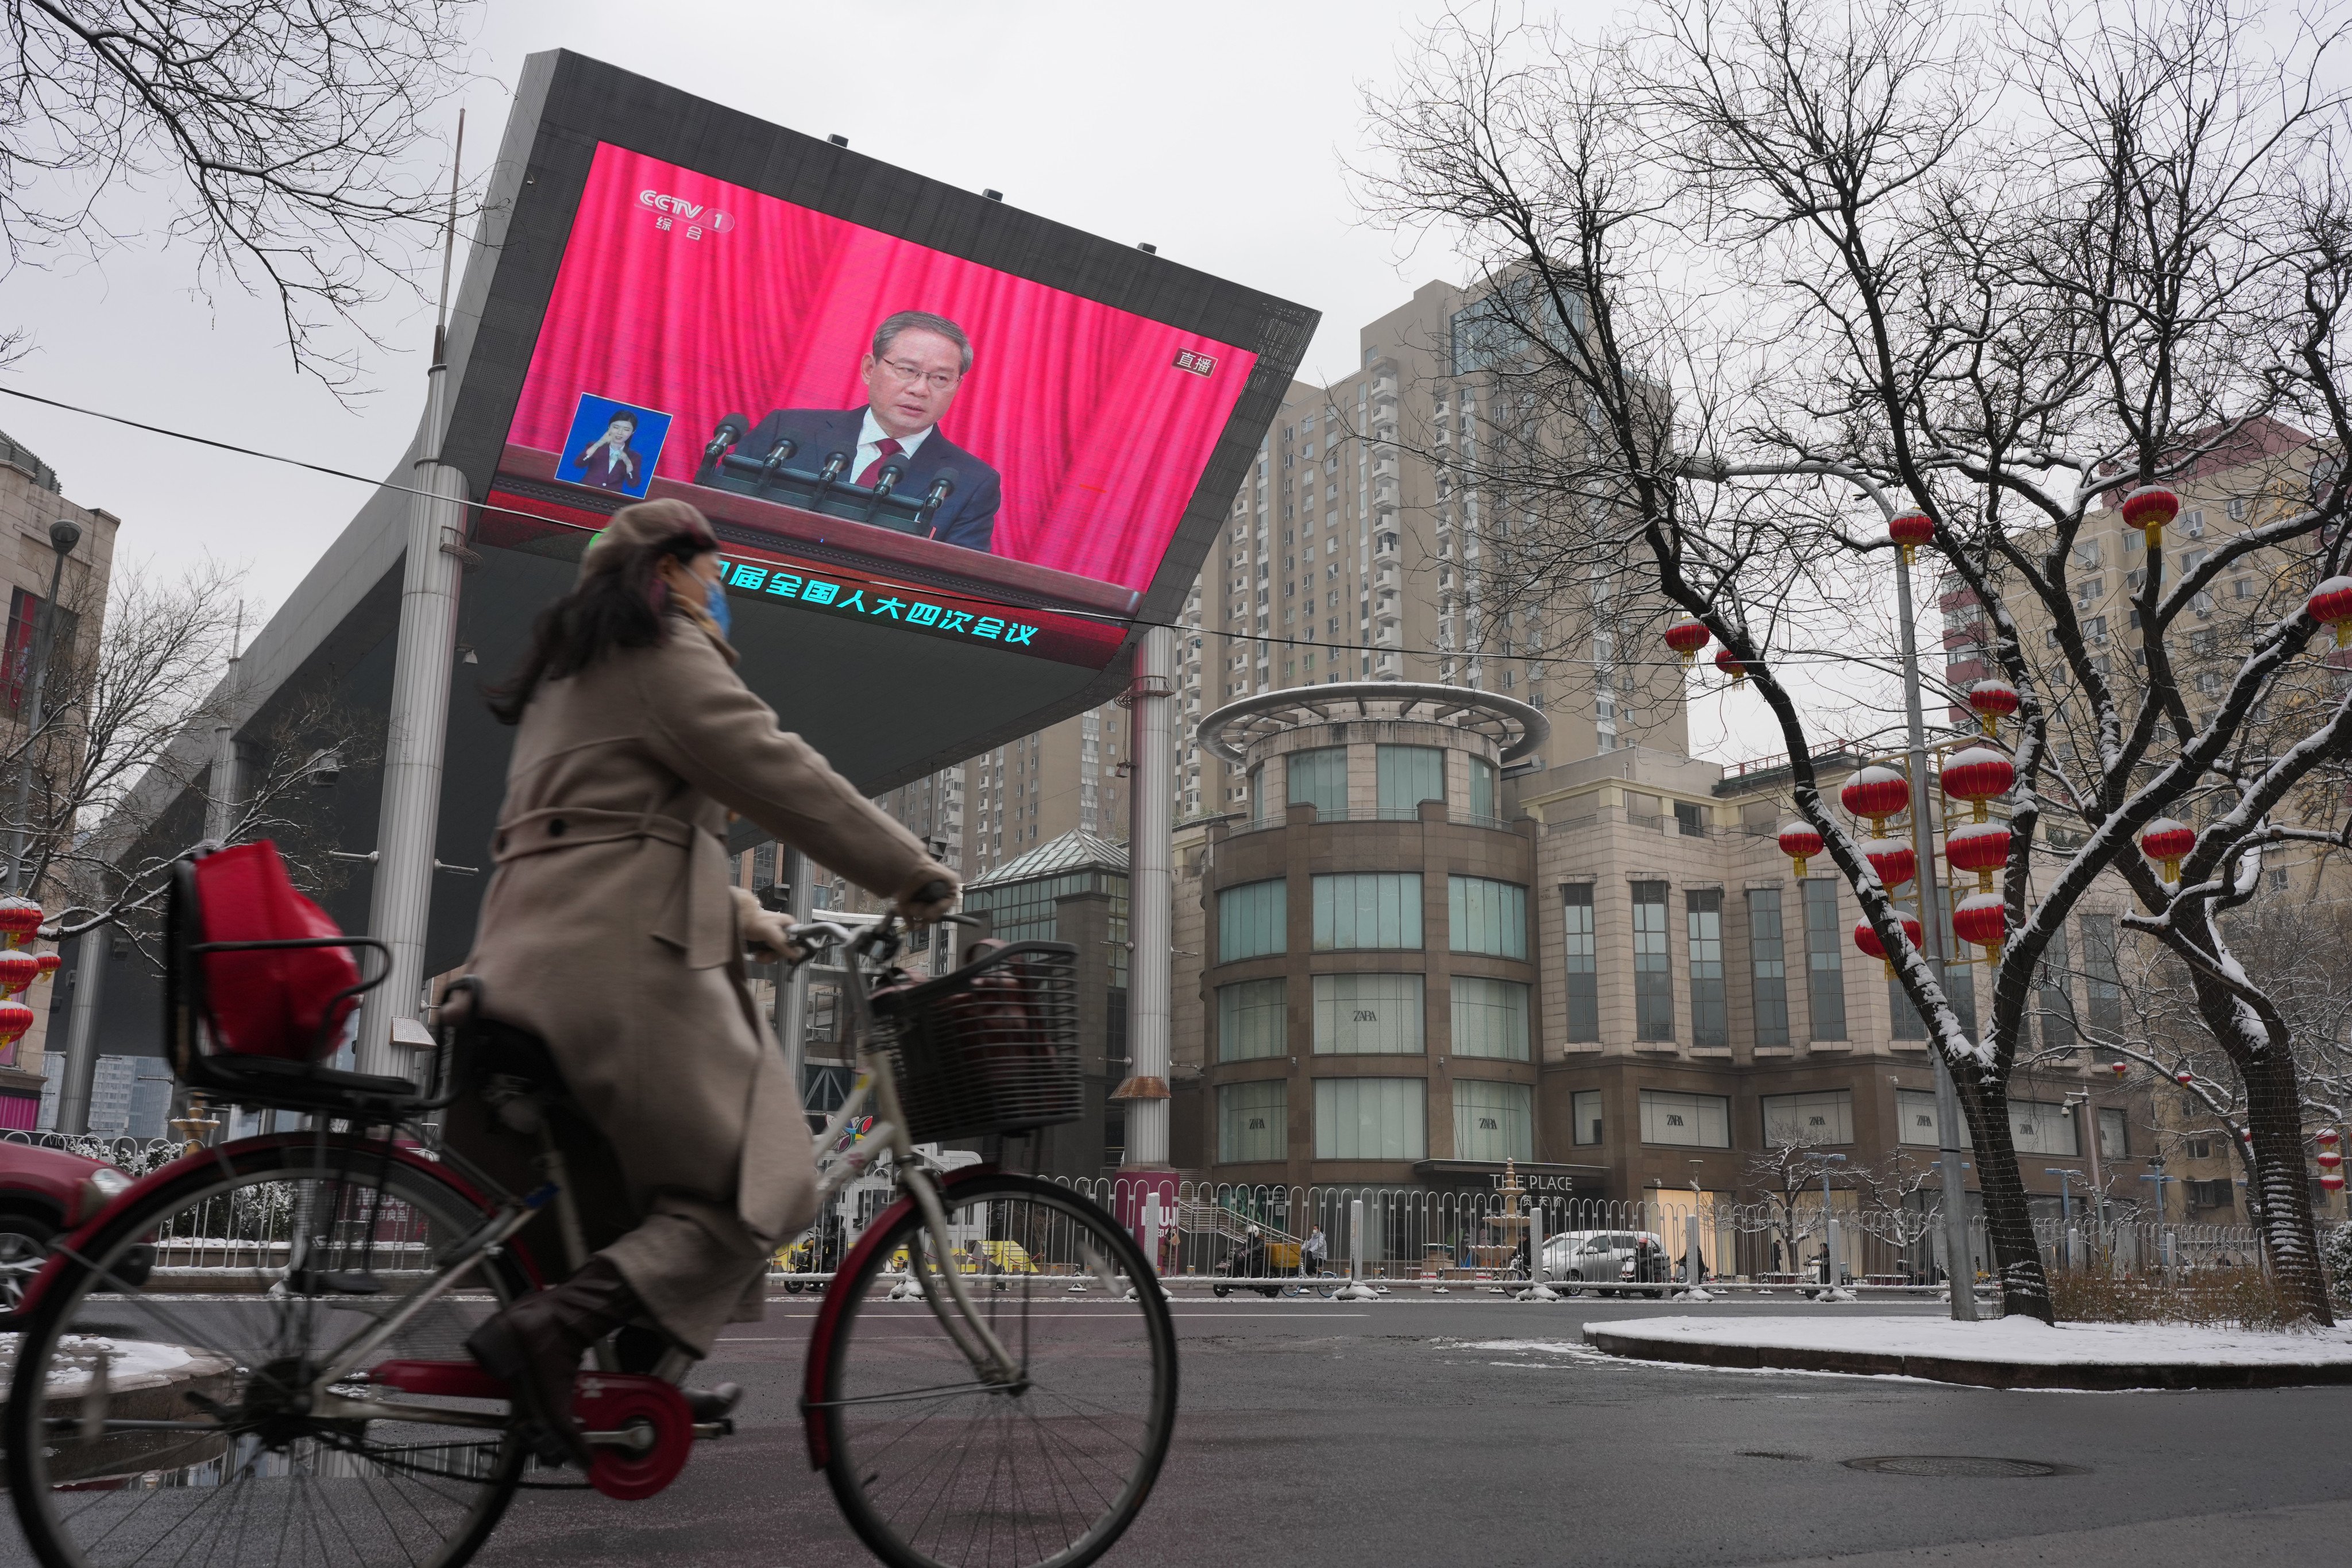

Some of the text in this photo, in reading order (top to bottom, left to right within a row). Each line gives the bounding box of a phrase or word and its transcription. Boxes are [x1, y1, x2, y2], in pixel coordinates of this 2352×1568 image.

[639, 190, 723, 229] CCTV 1
[655, 216, 702, 241] 综合
[1177, 352, 1212, 373] 直播
[1353, 1010, 1377, 1021] ZARA
[1249, 1118, 1265, 1129] ZARA
[1479, 1118, 1497, 1129] ZARA
[1667, 1114, 1683, 1126] ZARA
[1809, 1116, 1825, 1126] ZARA
[1916, 1115, 1932, 1126] ZARA
[1530, 1175, 1573, 1191] PLACE
[1141, 1206, 1179, 1227] UJI
